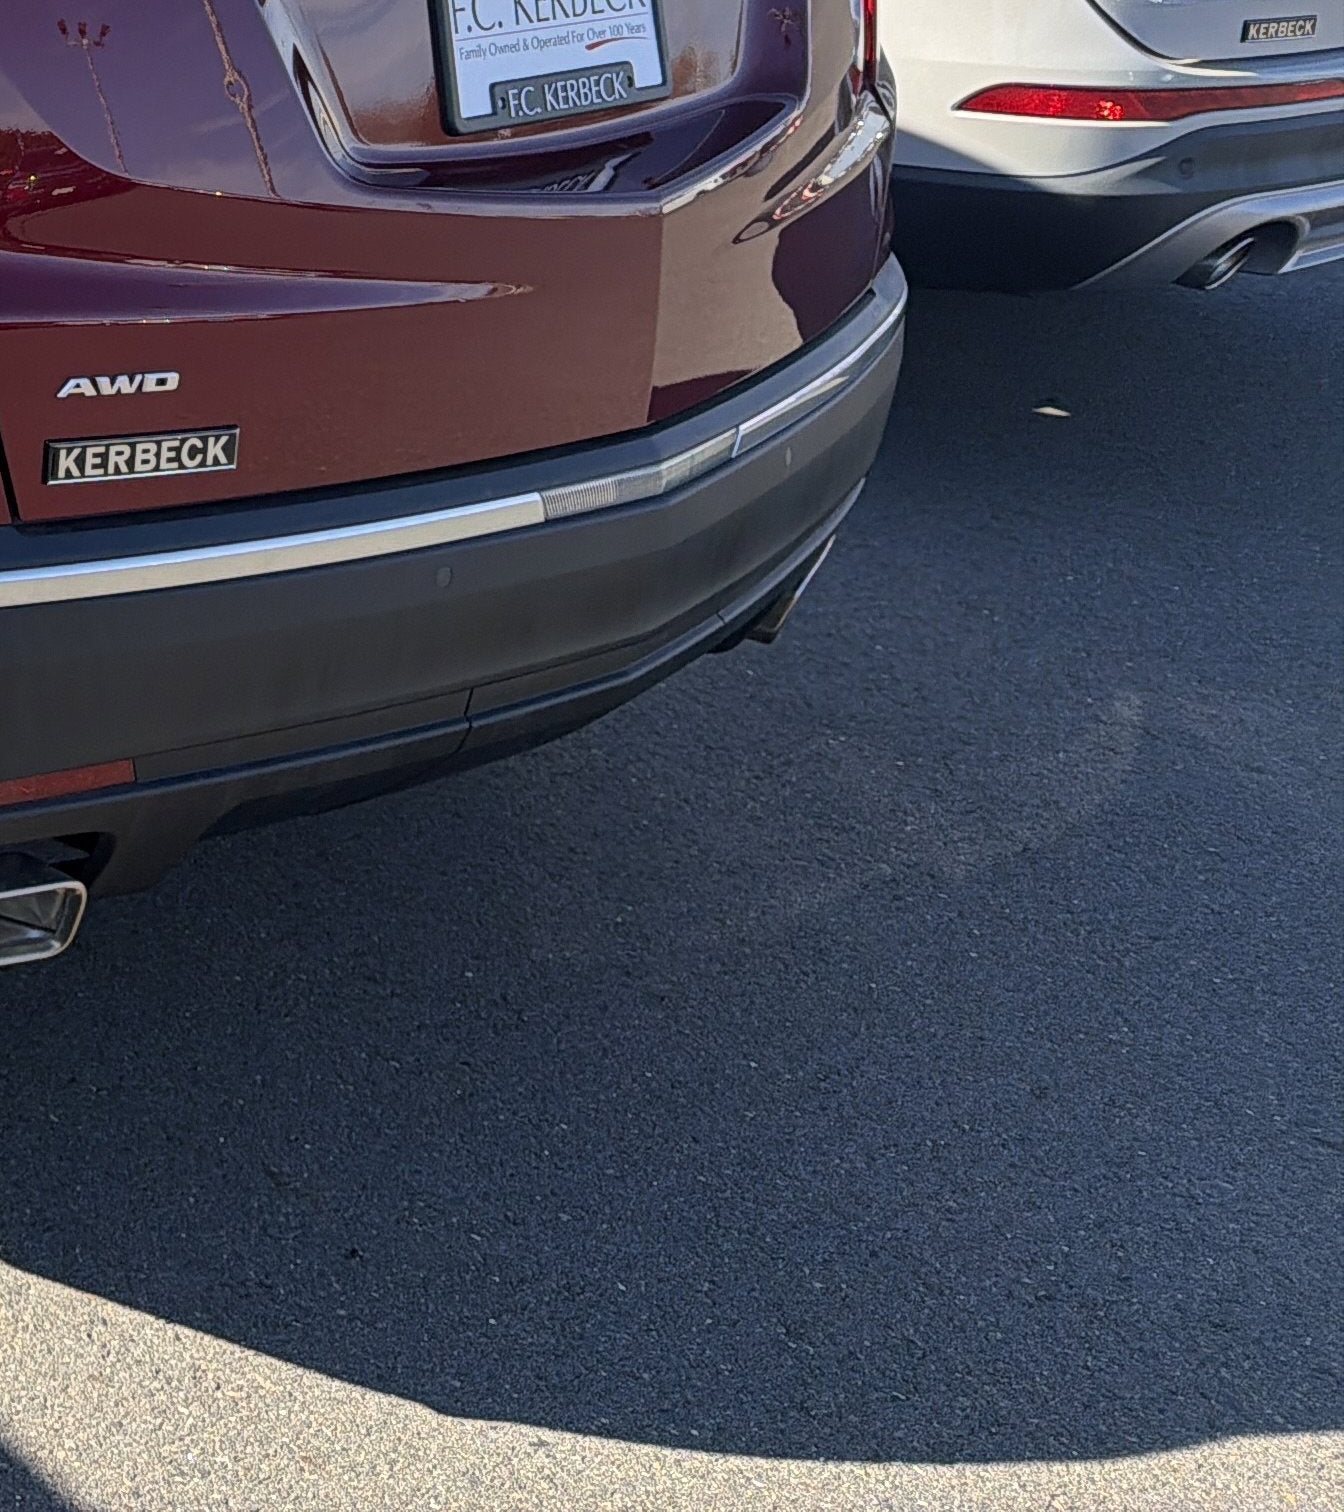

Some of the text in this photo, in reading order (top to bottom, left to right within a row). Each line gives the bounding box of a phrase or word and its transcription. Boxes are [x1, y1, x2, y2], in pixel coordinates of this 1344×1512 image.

[459, 21, 647, 61] Family Owned & Operated For Over 100 Years
[1248, 20, 1314, 39] KERBECK
[508, 70, 628, 118] F.C. KERBECK
[56, 371, 180, 399] AWD
[57, 434, 231, 479] KERBECK
